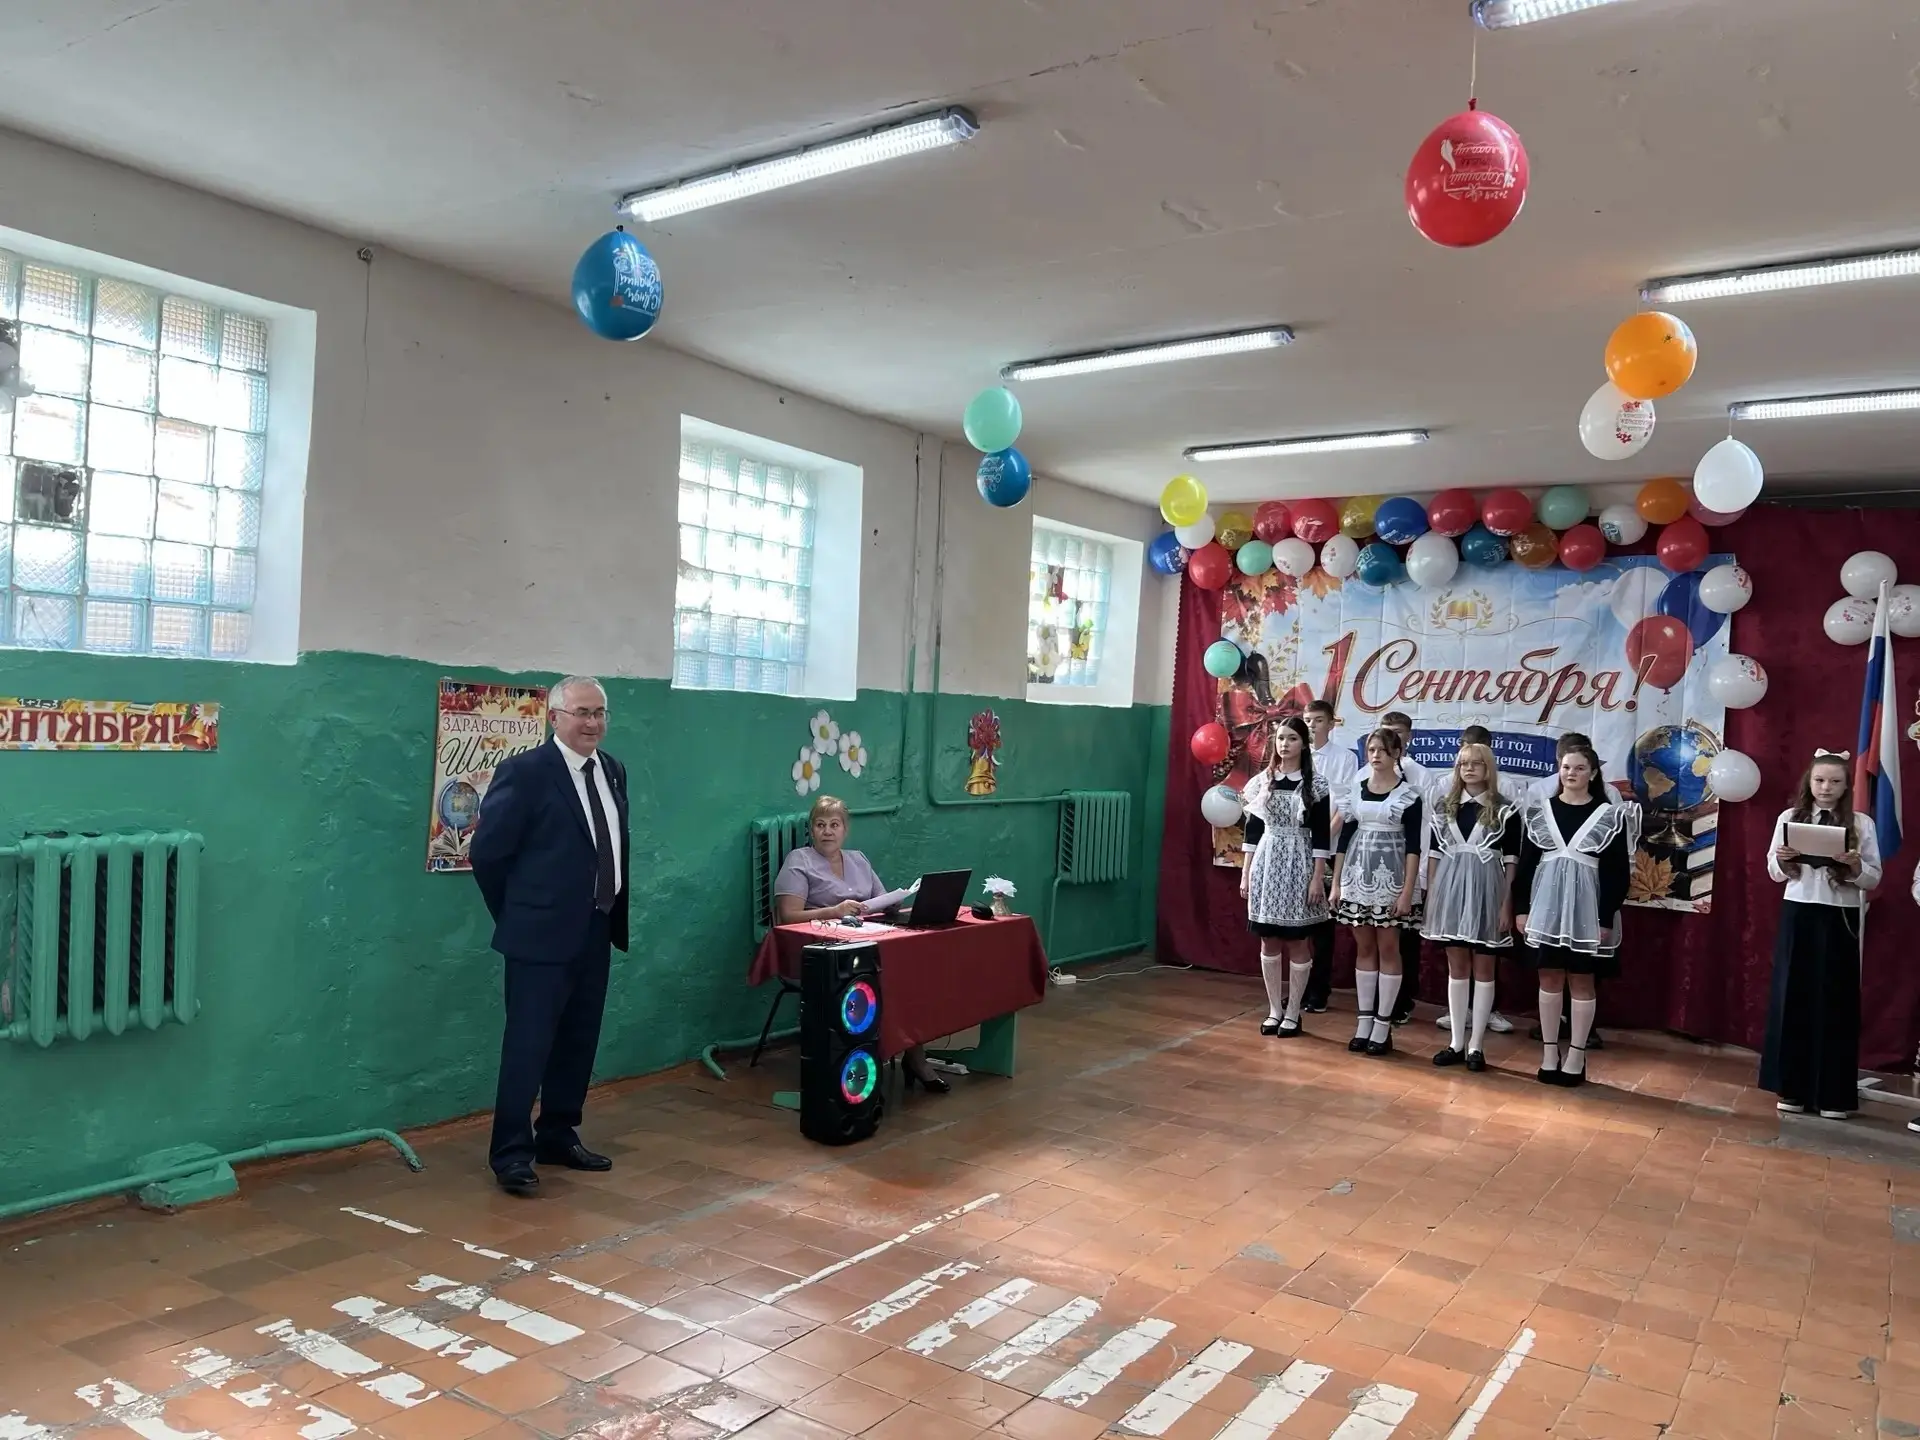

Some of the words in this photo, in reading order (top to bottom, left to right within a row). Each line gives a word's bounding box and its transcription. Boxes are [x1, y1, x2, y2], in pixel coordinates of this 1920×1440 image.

[1322, 630, 1357, 726] 1
[1352, 637, 1658, 726] Сентября!
[443, 716, 543, 737] ЗДРАВСТВУЙ,
[1405, 736, 1436, 750] усть
[1508, 740, 1533, 754] год
[1494, 755, 1554, 772] пешным
